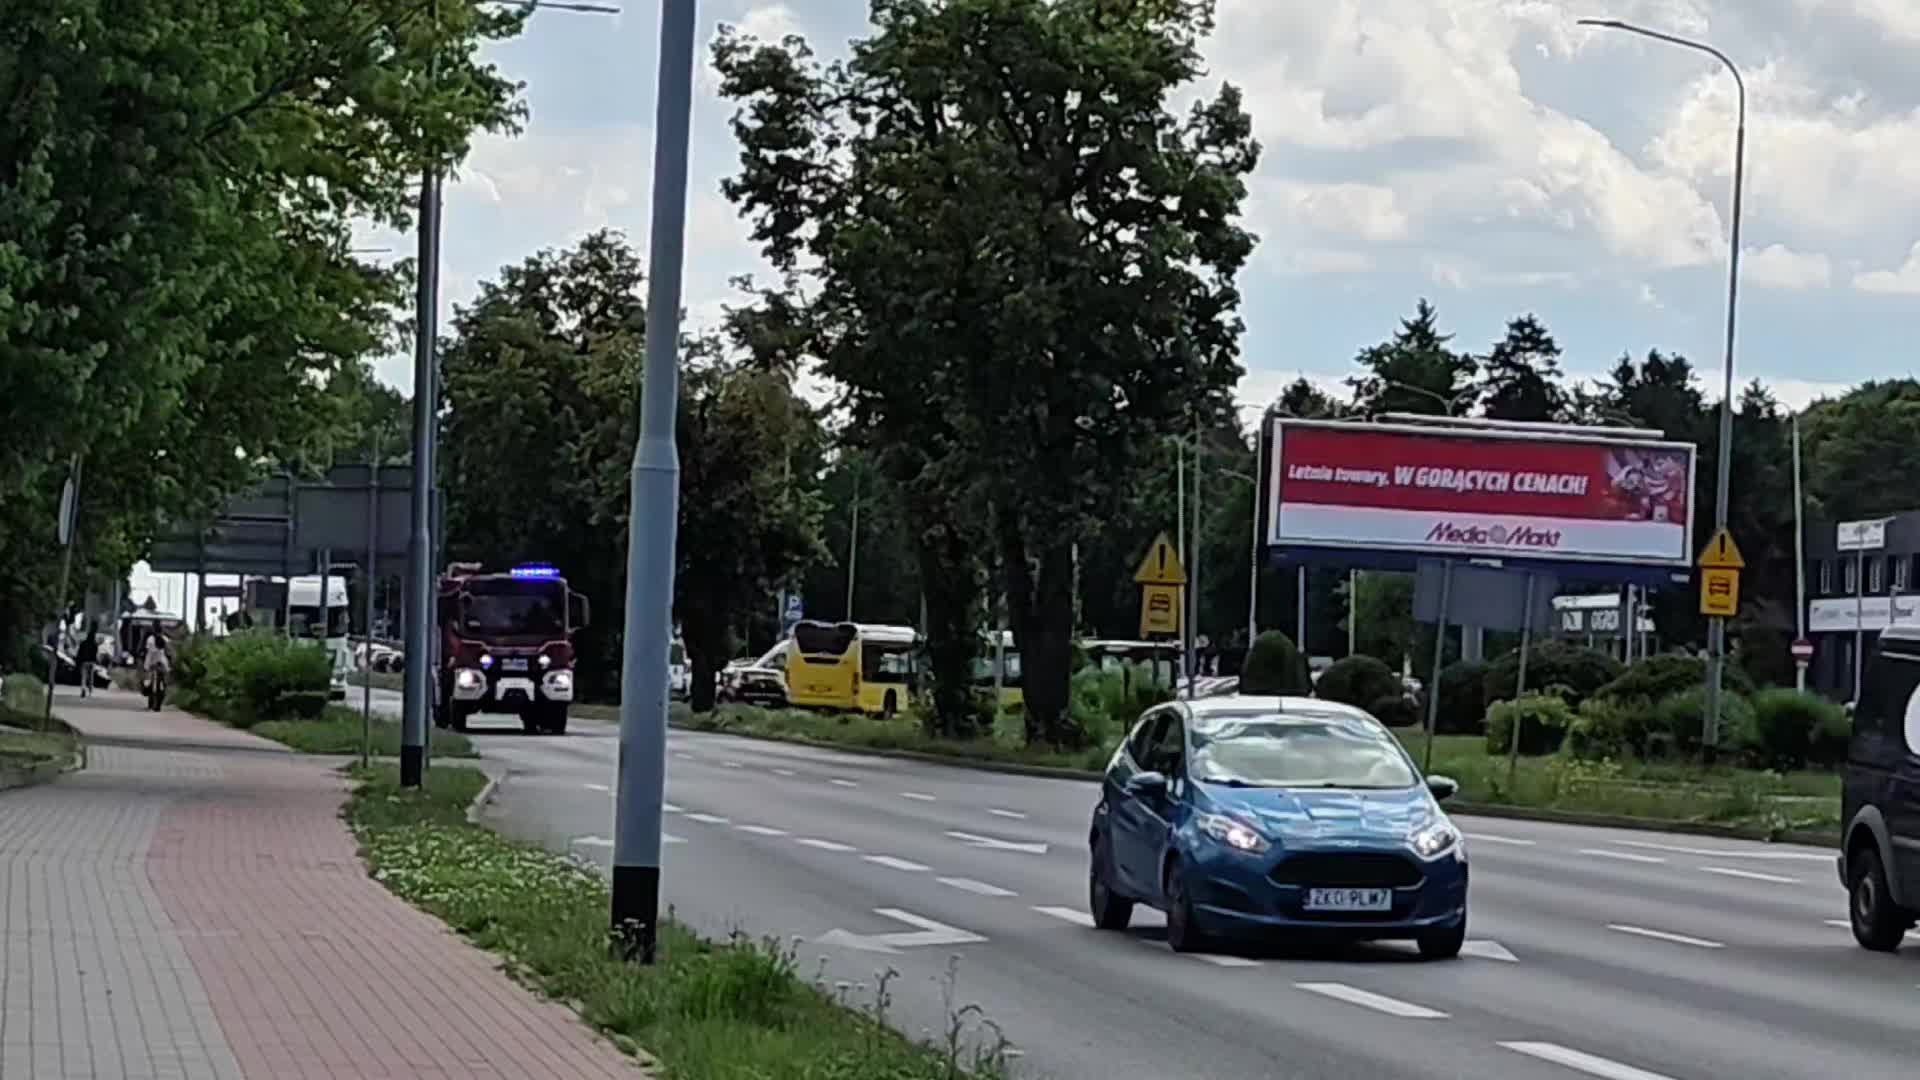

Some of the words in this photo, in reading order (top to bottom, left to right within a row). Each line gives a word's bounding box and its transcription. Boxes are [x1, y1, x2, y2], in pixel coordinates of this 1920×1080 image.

[1394, 465, 1415, 485] W
[1416, 466, 1510, 492] GORĄCYCH
[1513, 472, 1588, 496] CENACH!
[1425, 521, 1488, 544] Media
[1505, 526, 1561, 547] Markt
